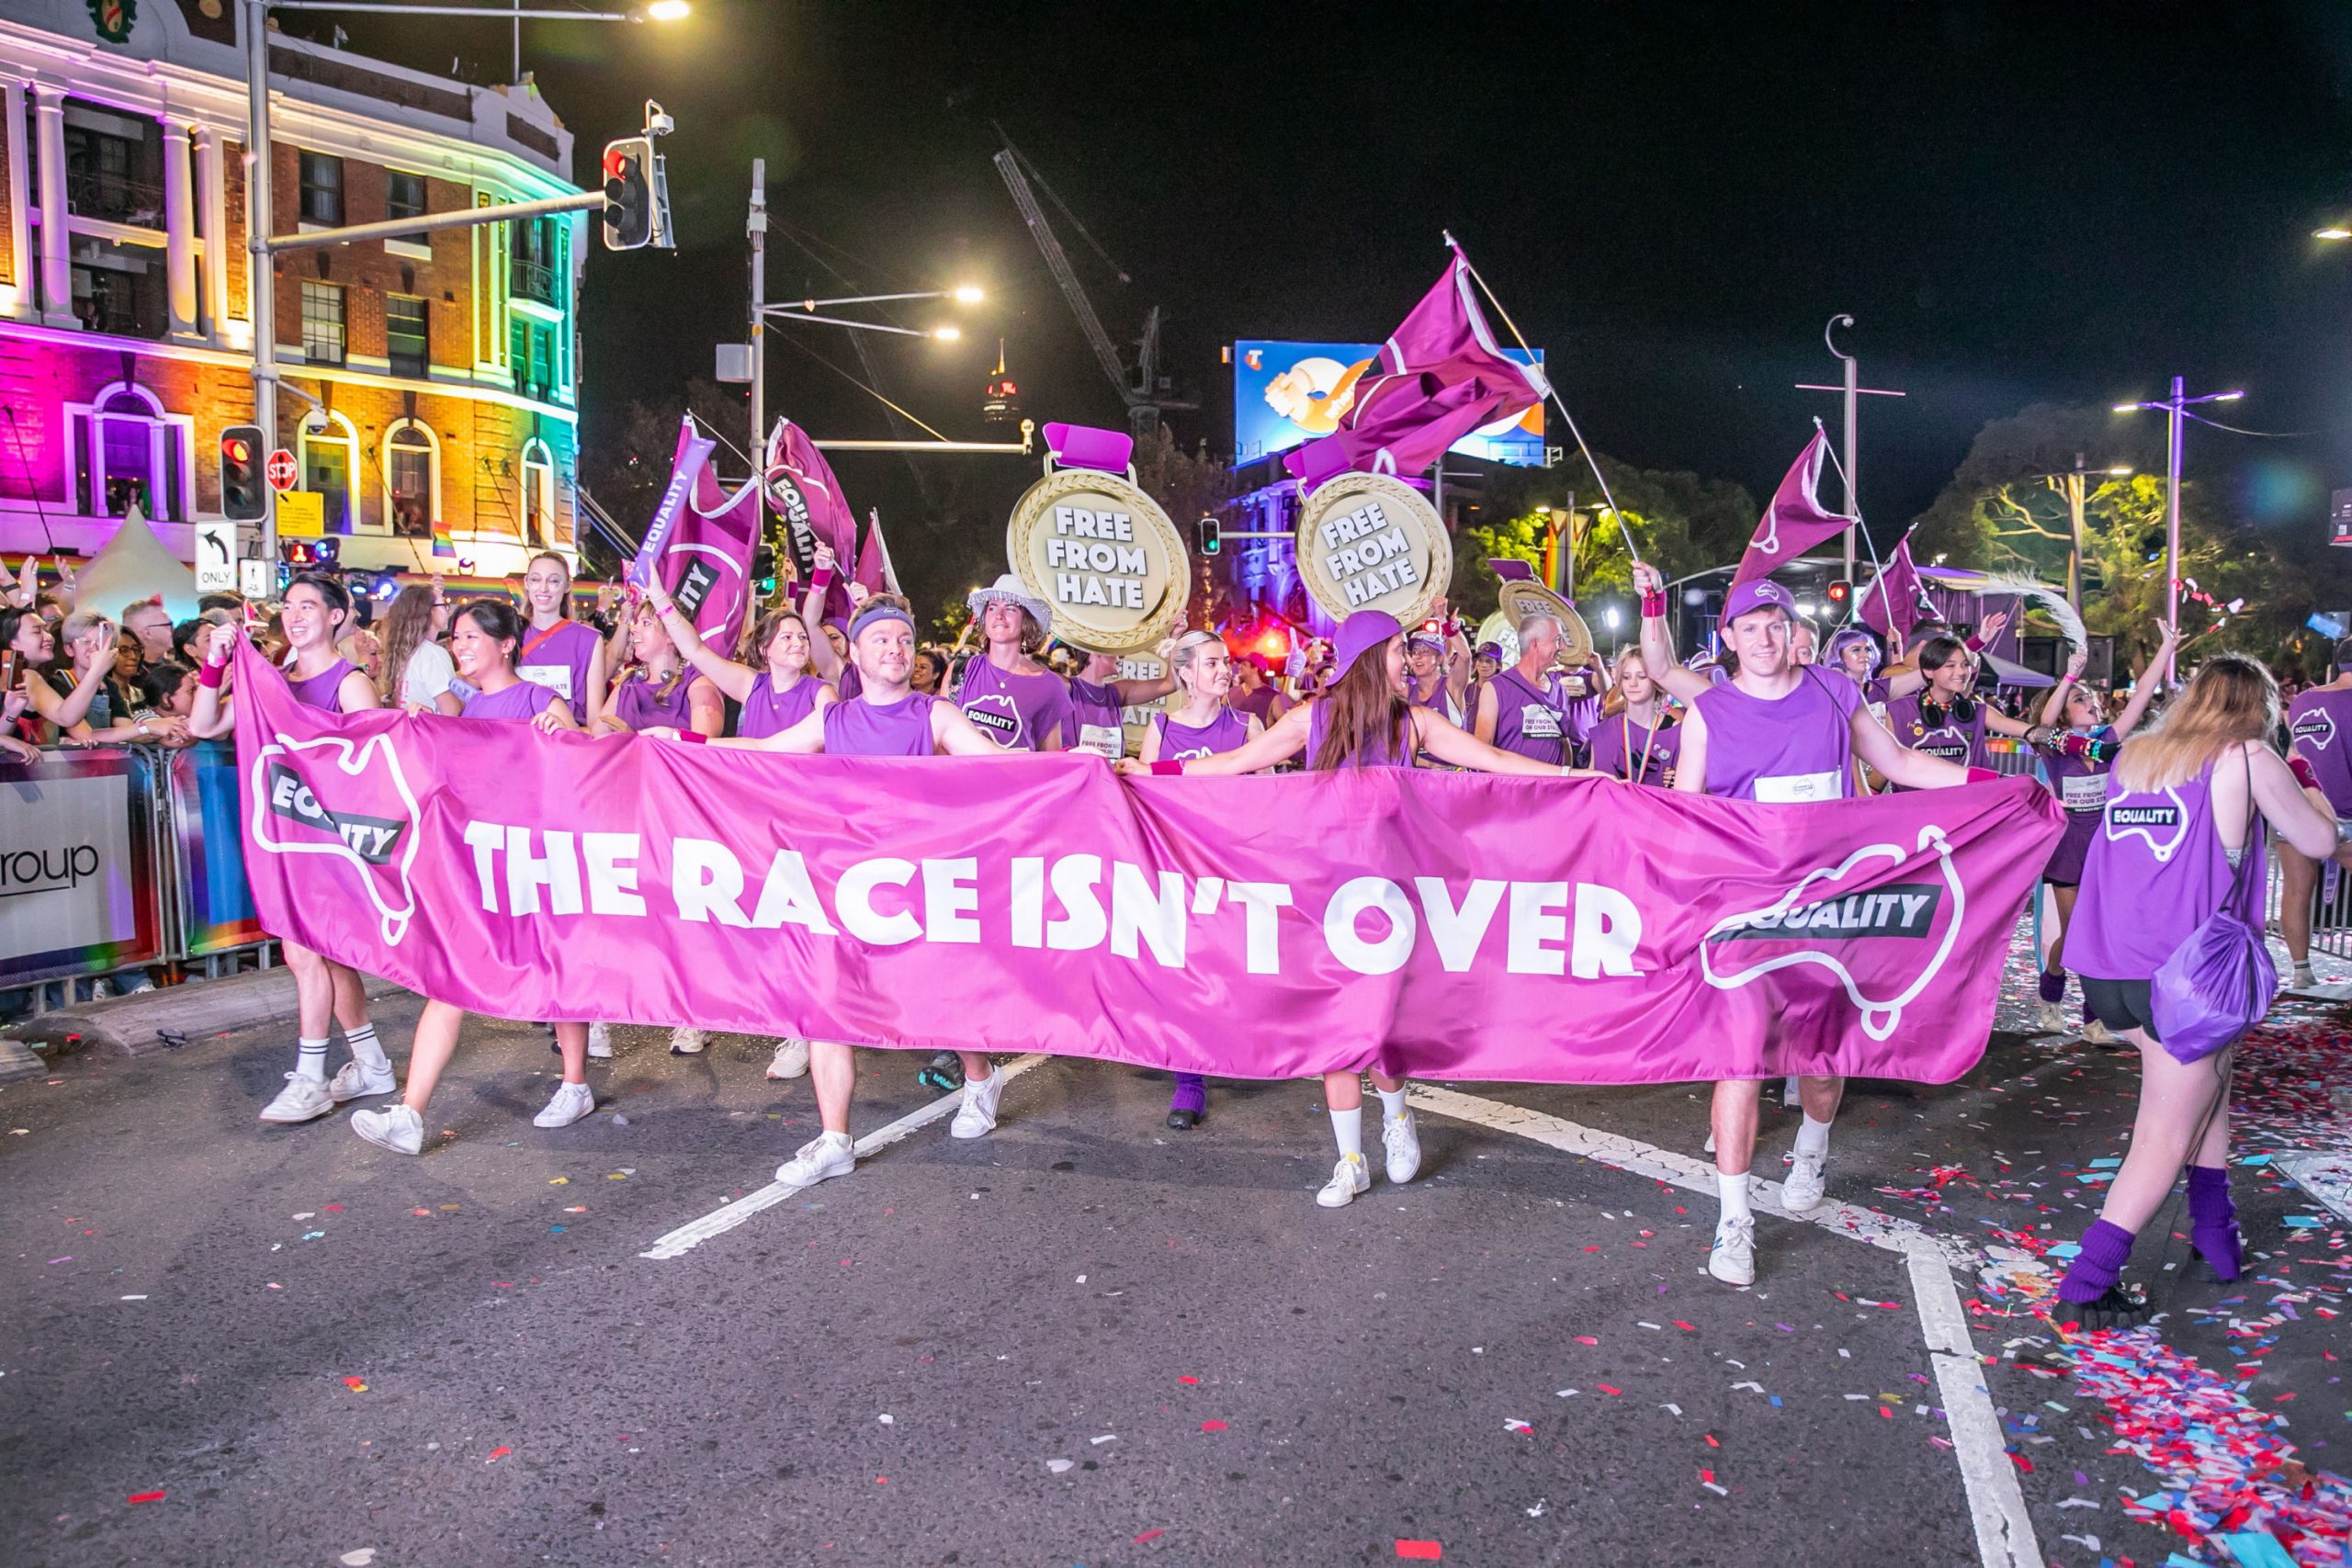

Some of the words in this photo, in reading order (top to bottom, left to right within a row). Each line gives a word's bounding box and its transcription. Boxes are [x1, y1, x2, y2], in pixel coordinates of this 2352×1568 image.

[269, 461, 296, 479] STOP
[642, 469, 688, 554] EQUALITY
[1056, 506, 1133, 542] FREE
[1320, 502, 1388, 549] FREE
[1046, 538, 1147, 576] FROM
[1325, 526, 1411, 581] FROM
[202, 571, 231, 583] ONLY
[678, 562, 710, 611] ITY
[1057, 572, 1144, 609] HATE
[1343, 557, 1419, 606] HATE
[1516, 599, 1555, 615] FREE
[967, 709, 1014, 729] EQUALITY
[1122, 705, 1161, 726] ATE
[2295, 724, 2326, 733] EQUALITY
[272, 775, 398, 855] EQITY
[2113, 808, 2176, 824] EQUALITY
[0, 845, 98, 888] roup
[463, 819, 647, 917] THE
[672, 837, 980, 945] RACE
[1011, 853, 1294, 975] ISN'T
[1323, 876, 1646, 979] OVER
